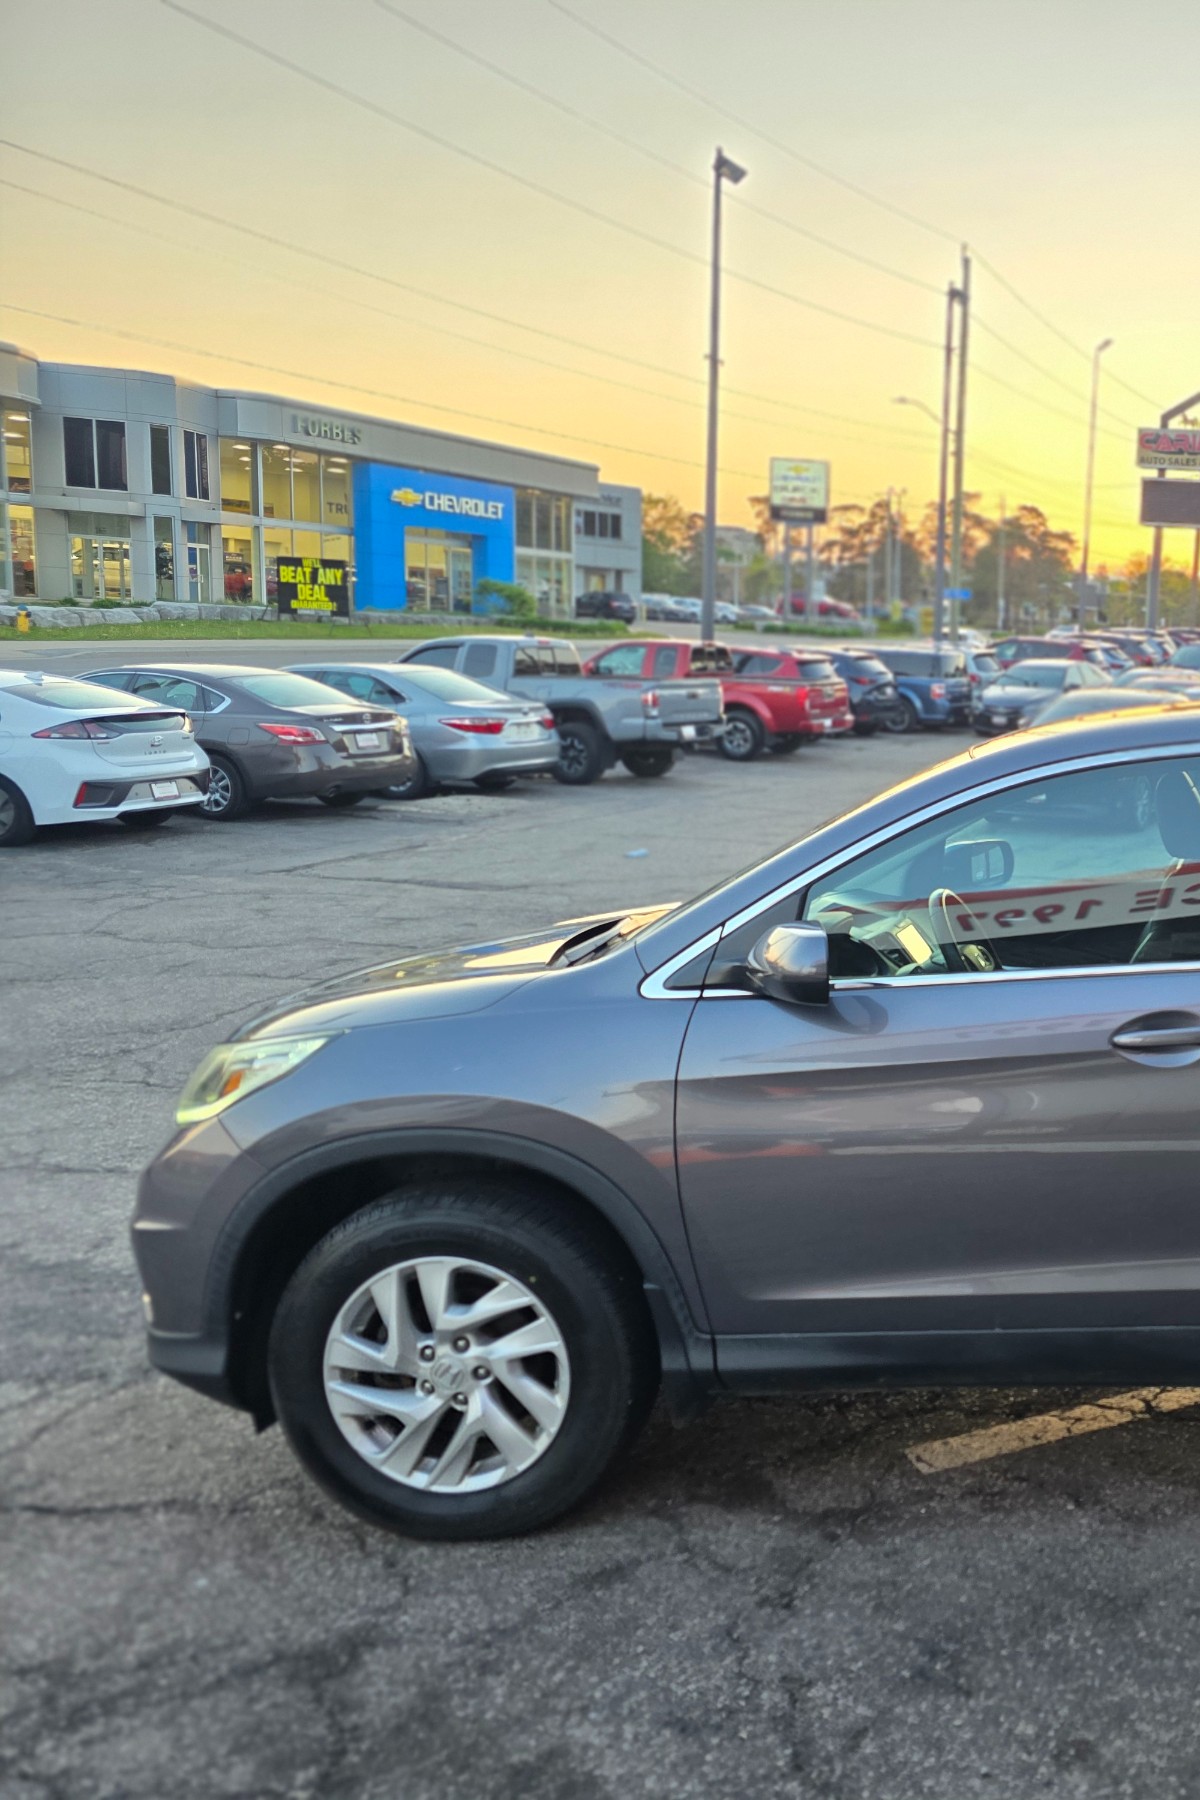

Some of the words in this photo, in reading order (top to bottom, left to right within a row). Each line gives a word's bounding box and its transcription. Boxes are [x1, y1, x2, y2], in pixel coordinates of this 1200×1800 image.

[291, 415, 363, 444] FORBES
[1139, 456, 1166, 466] AUTO
[1167, 457, 1197, 468] SALES
[425, 491, 505, 520] CHEVROLET
[280, 565, 312, 583] BEAT
[317, 567, 344, 585] ANY
[297, 583, 330, 601] DEAL
